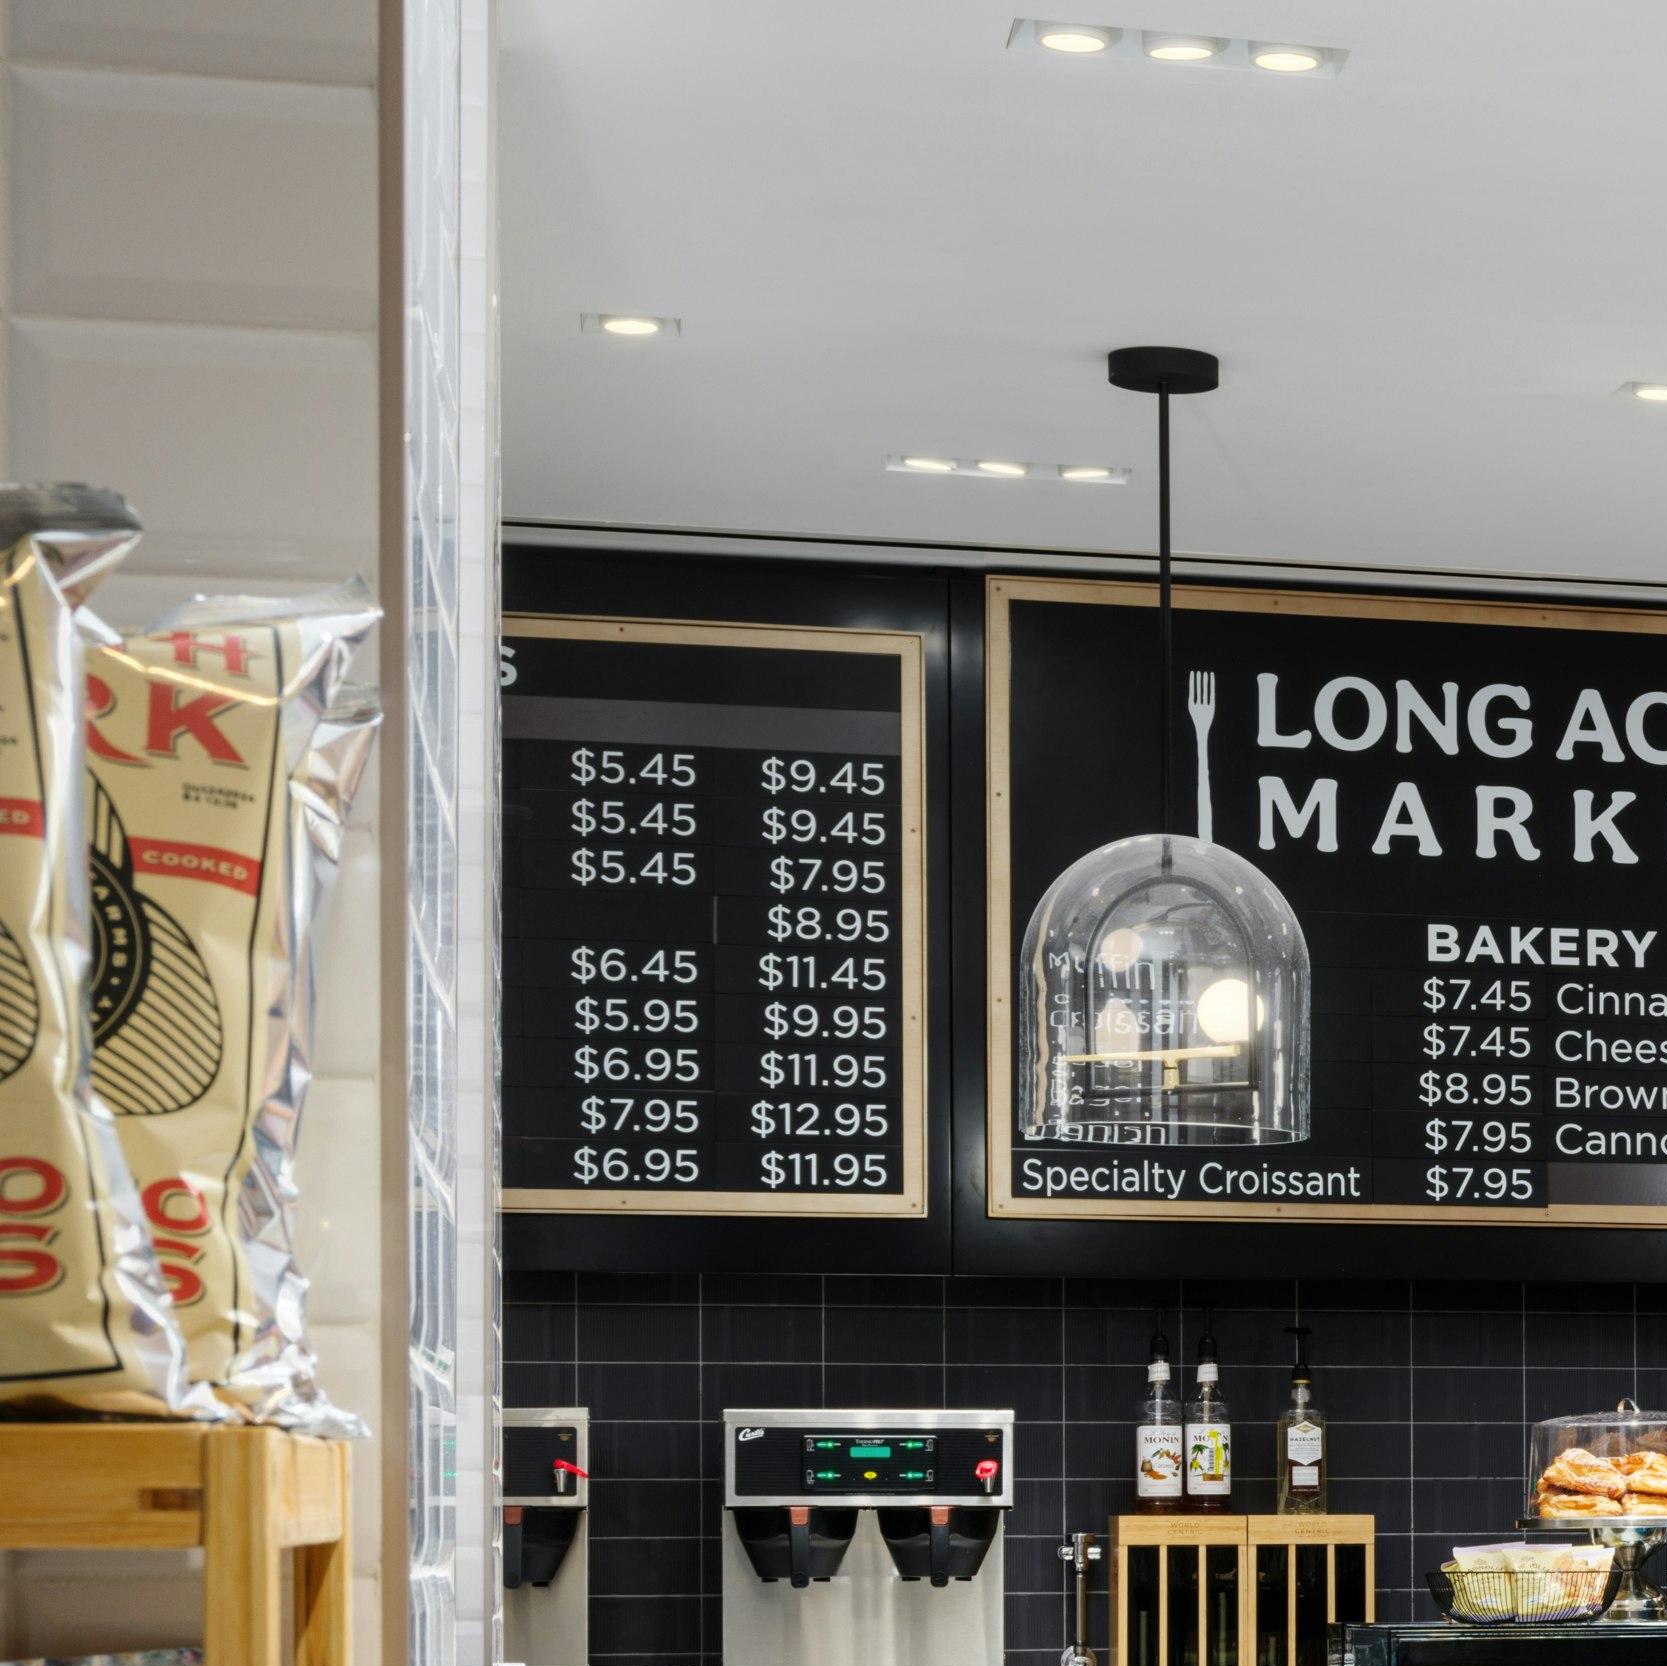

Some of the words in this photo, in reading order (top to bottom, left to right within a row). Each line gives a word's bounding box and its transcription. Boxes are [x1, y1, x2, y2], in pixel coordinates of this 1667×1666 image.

[1256, 672, 1533, 759] LONG
[571, 747, 696, 787] $5.45
[761, 756, 885, 796] $9.45
[571, 798, 696, 837] $5.45
[761, 806, 886, 846] $9.45
[142, 848, 248, 881] COOKED
[571, 847, 696, 886] $5.45
[770, 855, 886, 894] $7.95
[767, 903, 890, 943] $8.95
[571, 945, 698, 985] $6.45
[1427, 923, 1657, 968] BAKERY
[758, 952, 886, 991] $11.45
[1423, 976, 1532, 1014] $7.45
[575, 995, 699, 1035] $5.95
[763, 1001, 887, 1040] $9.95
[1422, 1022, 1531, 1060] $7.45
[574, 1044, 700, 1084] $6.95
[759, 1050, 887, 1089] $11.95
[1418, 1069, 1532, 1107] $8.95
[580, 1095, 699, 1134] $7.95
[751, 1099, 888, 1139] $12.95
[1424, 1117, 1532, 1155] $7.95
[573, 1145, 699, 1185] $6.95
[760, 1150, 887, 1189] $11.95
[1020, 1157, 1187, 1201] Specialty
[1198, 1160, 1362, 1199] Croissant
[1425, 1164, 1533, 1202] $7.95
[738, 1428, 765, 1442] Curtis
[1144, 1436, 1180, 1444] MONIN
